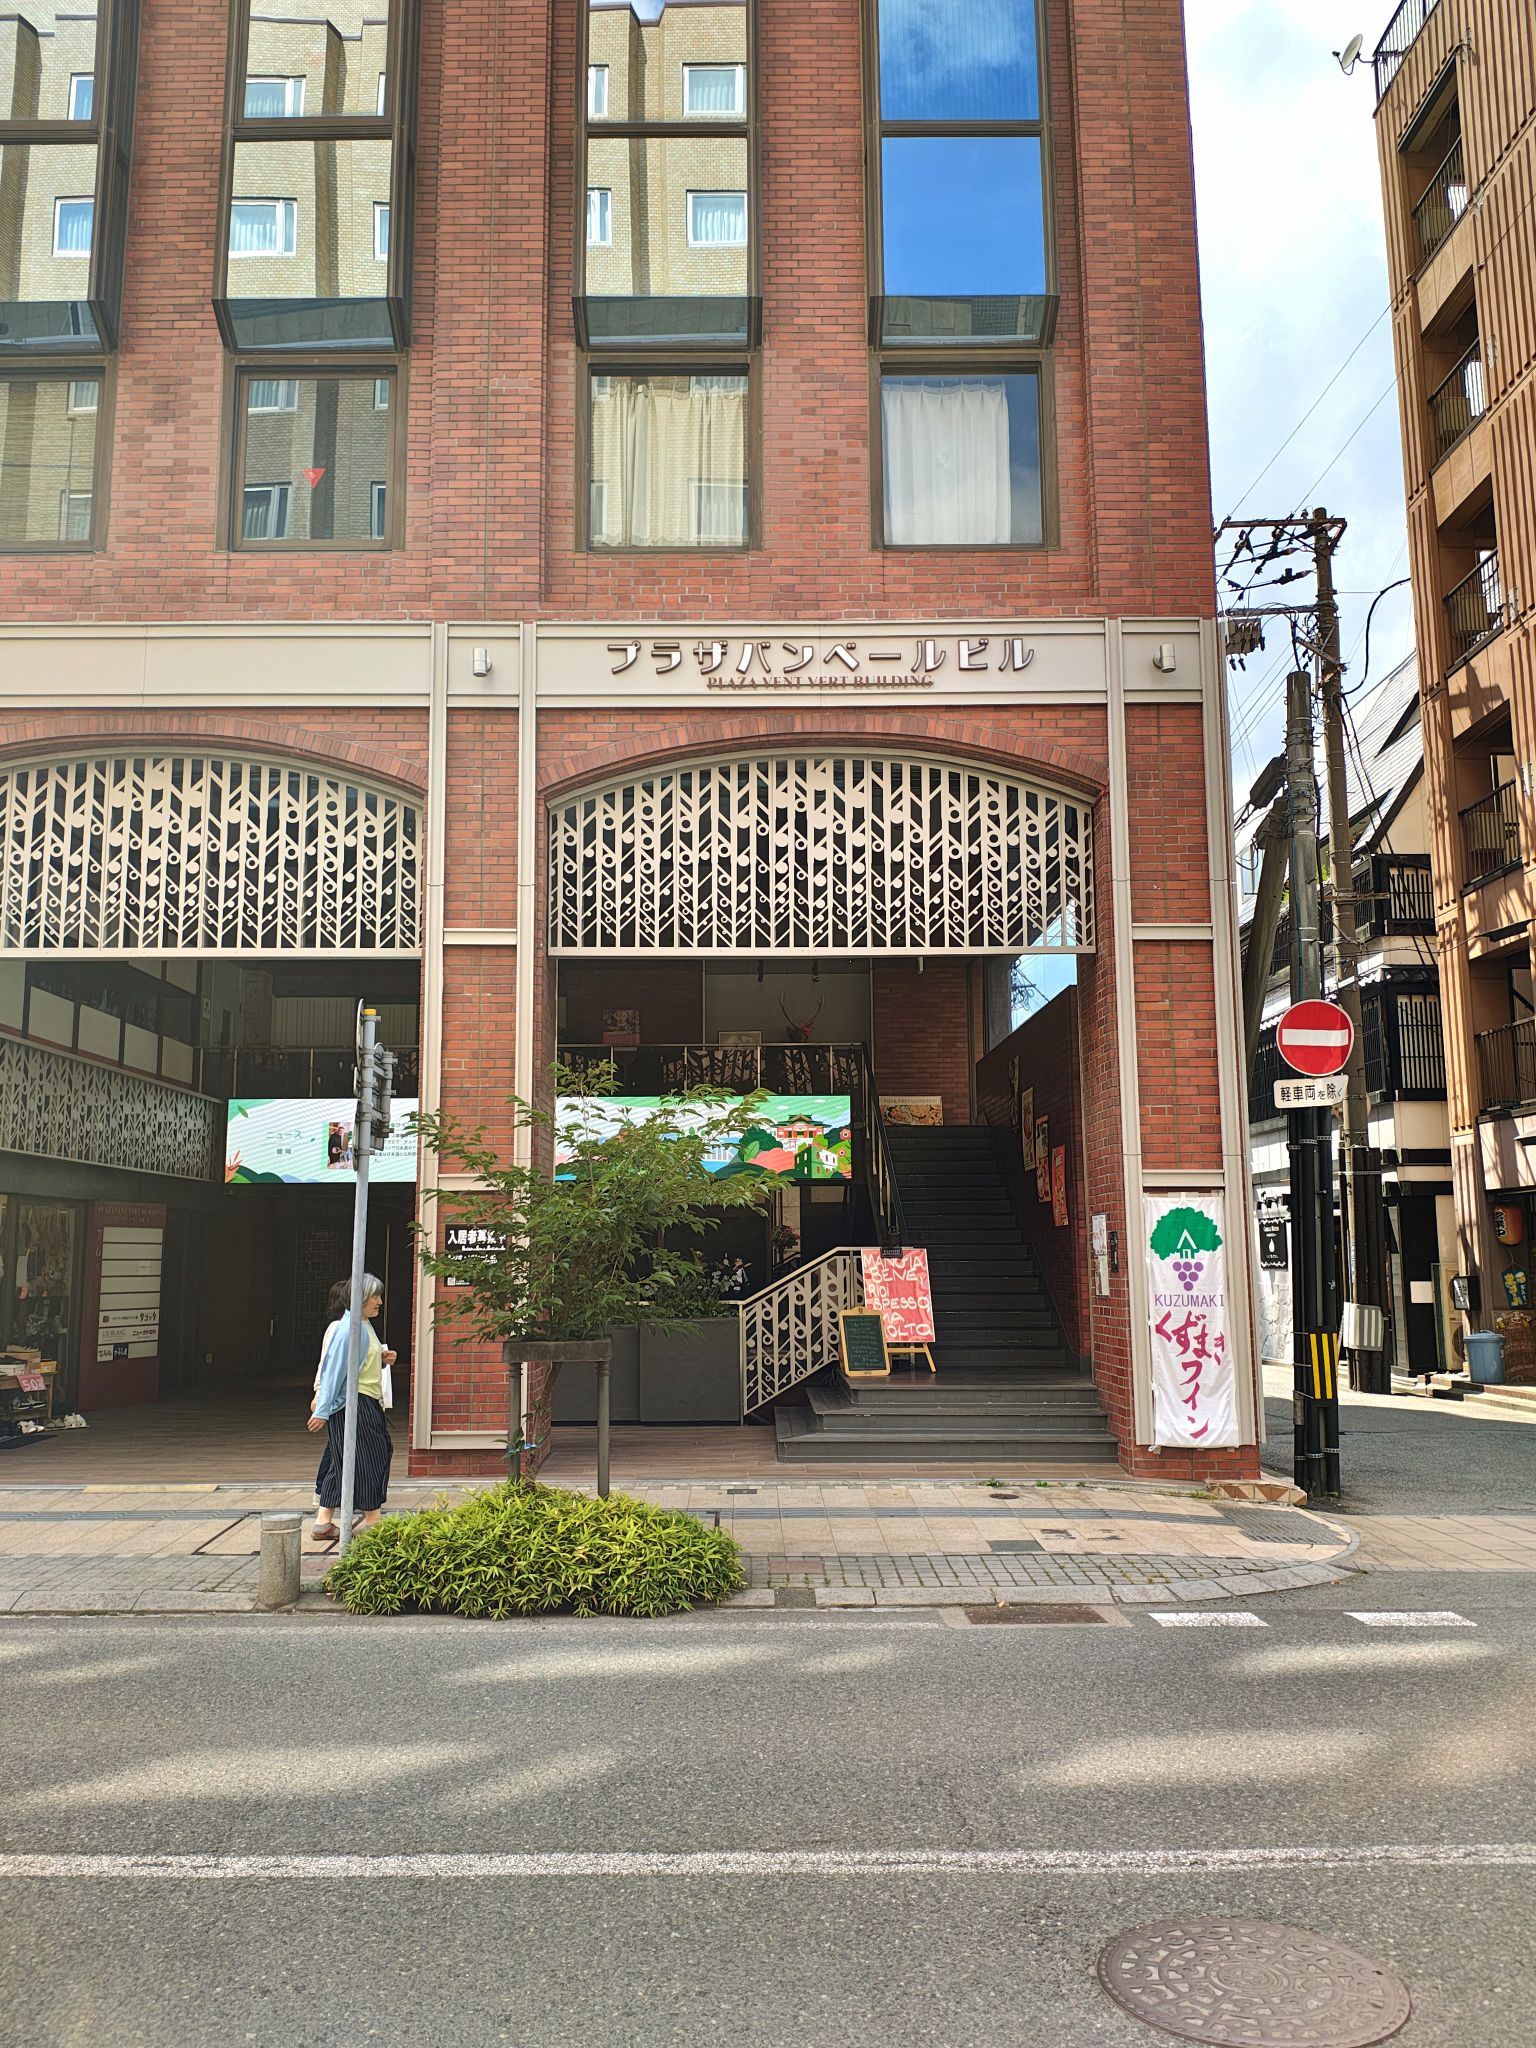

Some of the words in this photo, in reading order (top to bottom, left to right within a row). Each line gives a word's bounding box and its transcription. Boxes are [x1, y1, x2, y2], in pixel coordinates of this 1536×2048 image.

[607, 638, 1036, 675] プラザバンベールビル
[707, 676, 758, 689] PLAZA
[762, 676, 803, 689] VENT
[807, 675, 849, 688] VERT
[853, 674, 934, 688] BUILDING
[1280, 1083, 1343, 1102] 軽車両を除く
[1154, 1293, 1225, 1308] KUZUMAKI
[885, 1322, 933, 1338] OLTO.
[1155, 1310, 1225, 1366] くずまき
[1179, 1359, 1210, 1440] ワイン
